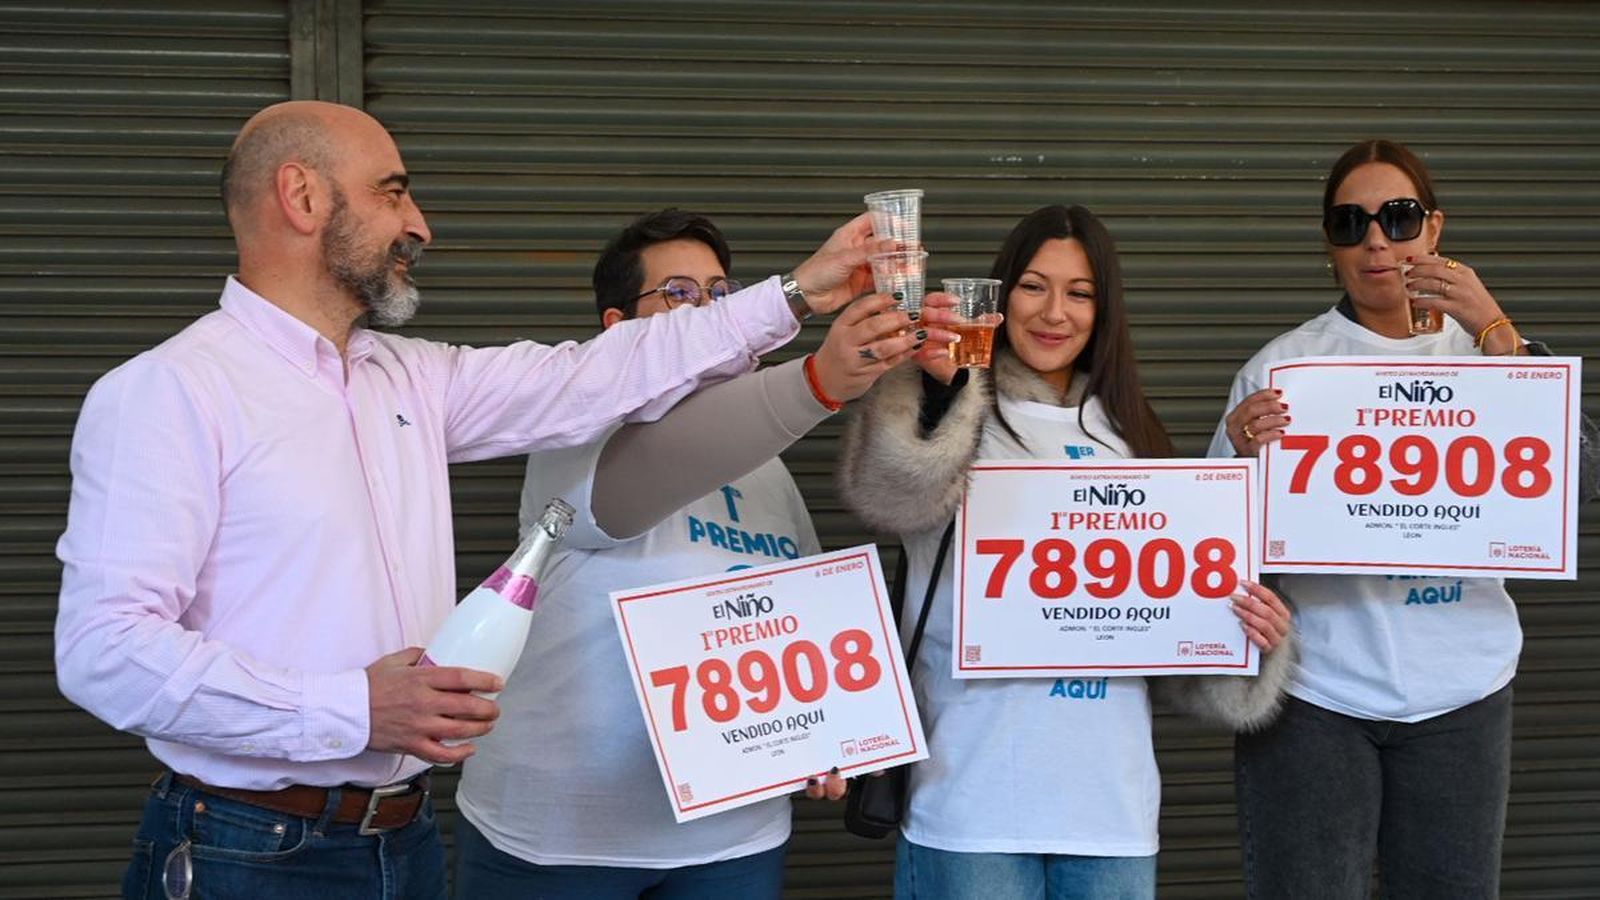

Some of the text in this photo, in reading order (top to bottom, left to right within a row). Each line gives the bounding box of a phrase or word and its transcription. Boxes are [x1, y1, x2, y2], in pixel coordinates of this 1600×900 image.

[1507, 371, 1563, 380] 6 DE ENERO
[1395, 380, 1454, 406] Niño
[1374, 409, 1477, 428] PREMIO
[1202, 473, 1214, 481] DE
[1216, 473, 1244, 481] ENERO
[1280, 434, 1553, 499] 78908
[1089, 483, 1146, 508] Niño
[1068, 512, 1167, 530] PREMIO
[1347, 503, 1481, 520] VENDIDO AQUÍ
[688, 516, 799, 560] PREMIO
[822, 567, 834, 576] DE
[835, 561, 864, 574] ENERO
[976, 538, 1238, 599] 78908
[1405, 580, 1463, 605] AQUÍ
[726, 593, 774, 620] Niño
[1042, 605, 1170, 621] VENDIDO AQUÍ
[715, 615, 798, 648] PREMIO
[650, 629, 882, 732] 78908
[1050, 677, 1109, 700] AQUÍ
[722, 708, 825, 745] VENDIDO AQUÍ
[860, 741, 900, 752] NACIONAL
